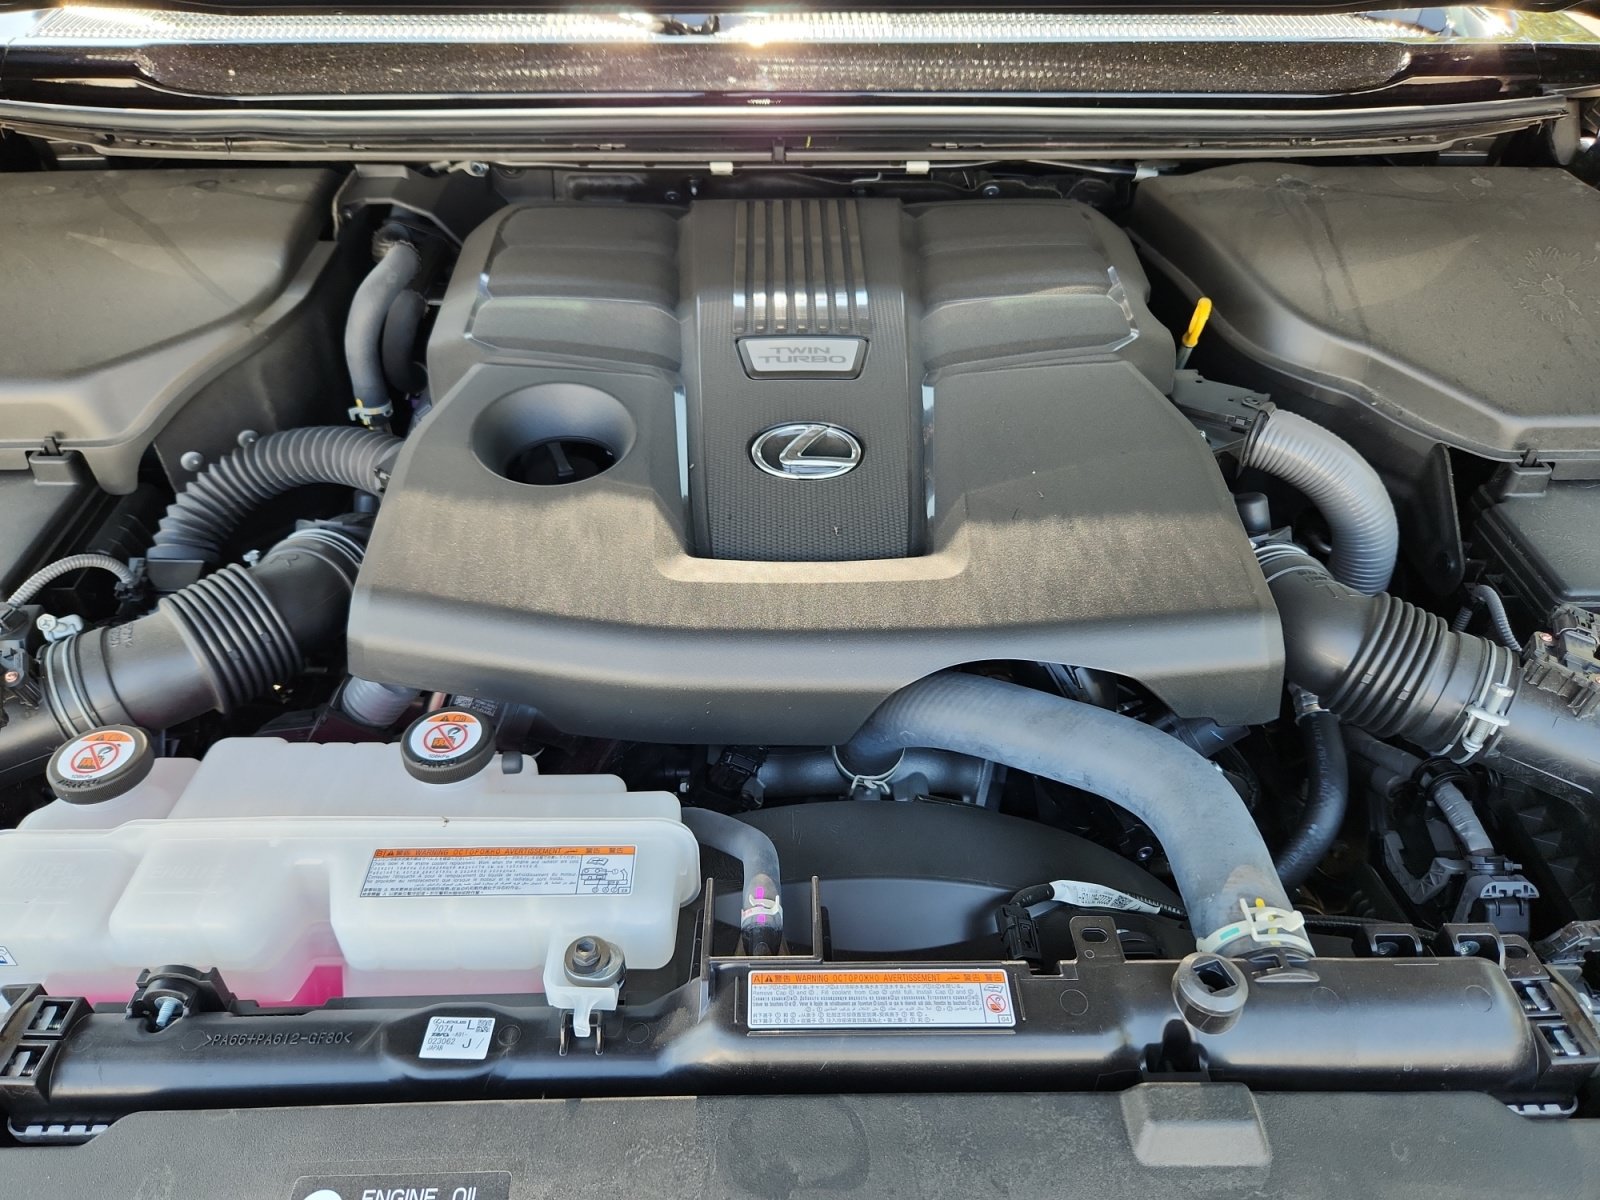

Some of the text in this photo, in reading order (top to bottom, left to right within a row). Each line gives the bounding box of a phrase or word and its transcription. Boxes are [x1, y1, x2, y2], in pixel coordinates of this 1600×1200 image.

[769, 346, 830, 354] TWIN
[796, 974, 828, 982] WARNING
[884, 973, 940, 982] AVERTISSEMENT
[467, 1020, 474, 1030] L
[462, 1038, 472, 1048] J
[362, 1188, 438, 1200] ENGINE
